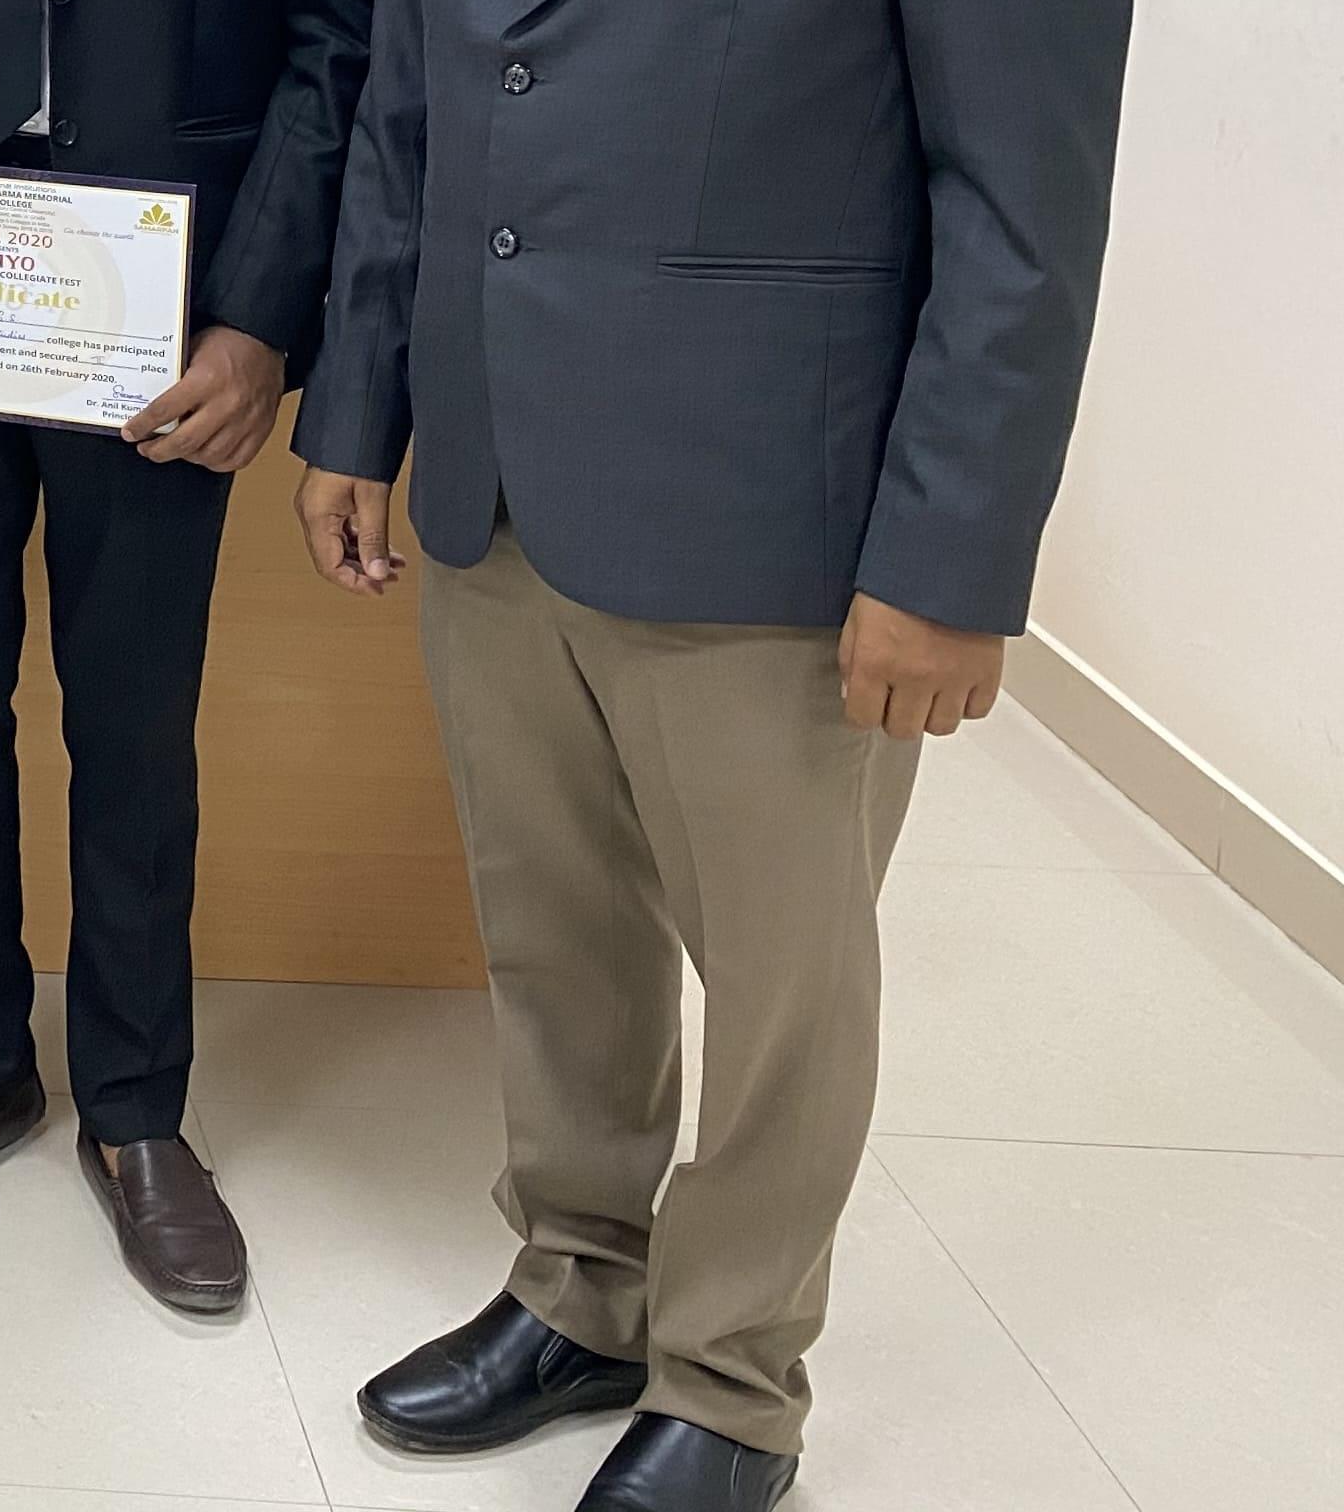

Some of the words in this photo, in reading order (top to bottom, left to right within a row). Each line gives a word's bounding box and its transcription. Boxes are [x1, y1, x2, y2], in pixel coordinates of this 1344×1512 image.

[24, 192, 72, 203] MEMORIAL
[7, 231, 52, 248] 2020
[59, 277, 81, 286] FEST
